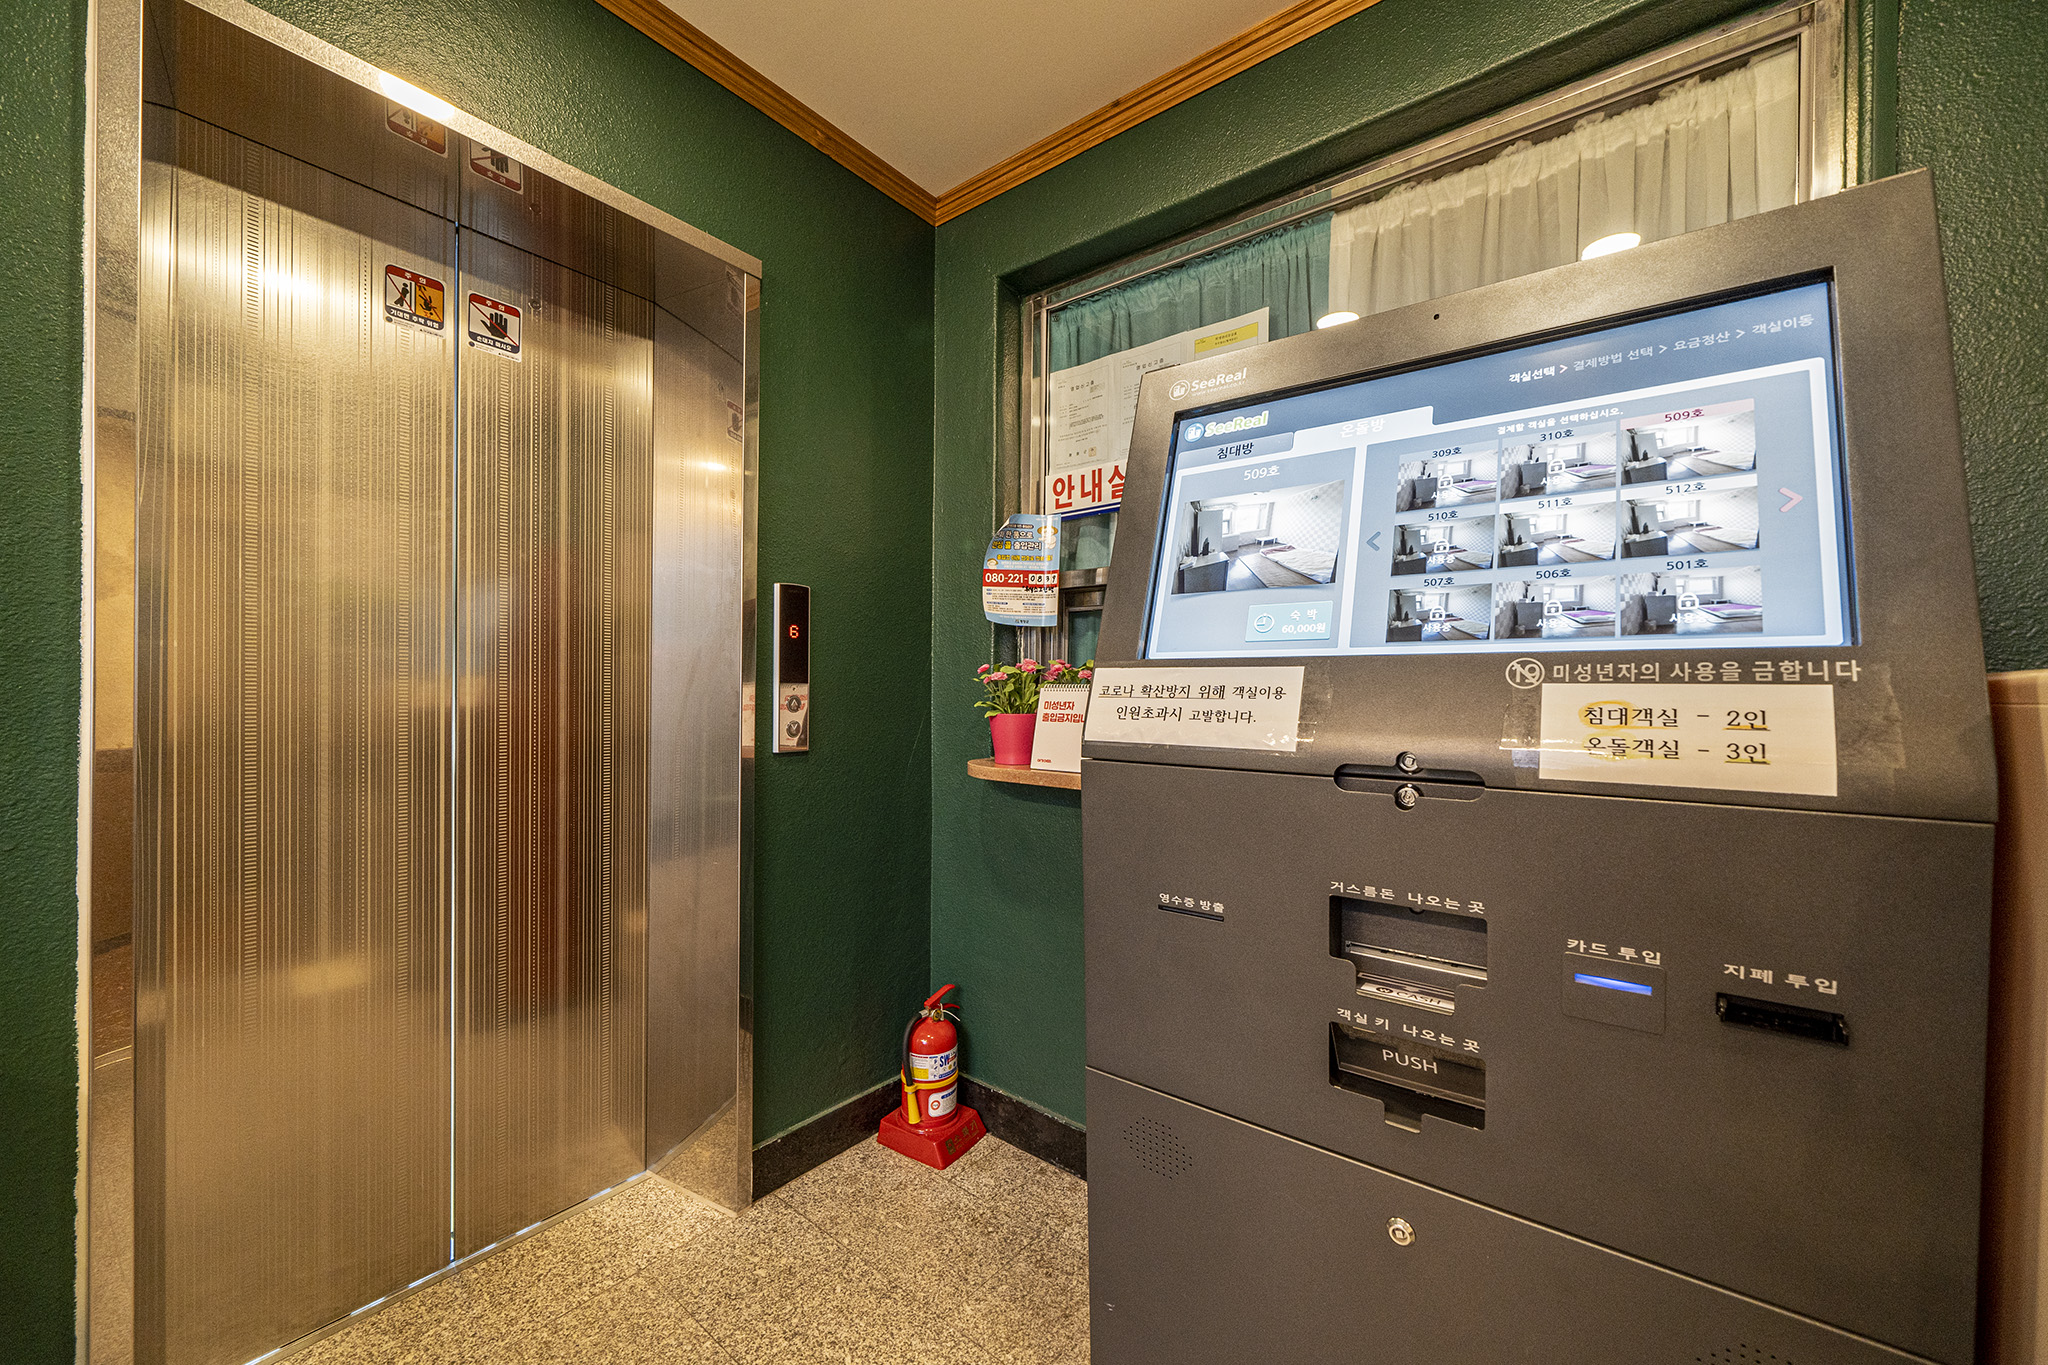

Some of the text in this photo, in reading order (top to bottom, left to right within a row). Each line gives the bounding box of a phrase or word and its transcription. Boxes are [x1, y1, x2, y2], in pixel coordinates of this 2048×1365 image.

[1508, 313, 1814, 383] 객실선택 결제방법 선택 요금정산 객실이동
[1191, 367, 1247, 391] SeeReal
[1204, 410, 1269, 437] SeeReal
[1527, 417, 1556, 429] 객실을
[1560, 407, 1624, 425] 선택하십시오.
[1664, 408, 1705, 423] 509호
[1340, 418, 1386, 438] 온돌방
[1540, 429, 1574, 441] 310호
[1217, 442, 1254, 459] 침대방
[1432, 446, 1462, 459] 309호
[1243, 465, 1280, 481] 509호
[1665, 482, 1706, 495] 512호
[1538, 497, 1573, 509] 511호
[1428, 510, 1458, 522] 510호
[1427, 554, 1456, 564] 사용중
[1665, 558, 1709, 570] 501호
[1423, 577, 1455, 587] 507호
[1535, 568, 1572, 580] 506호
[788, 624, 799, 639] 6
[1281, 622, 1326, 635] 60,000원
[1422, 622, 1452, 632] 사용중
[1553, 659, 1862, 683] 미성년자의 사용을 금합니다
[1099, 684, 1287, 700] 코로나 확산방지 위해 객실이용
[1043, 700, 1075, 711] 미성년자
[1116, 705, 1257, 724] 인원초과시 고발합니다.
[1584, 706, 1679, 728] 침대객실
[1726, 709, 1767, 730] 2인
[1583, 737, 1680, 760] 온돌객실
[1726, 742, 1767, 763] 3인
[1158, 893, 1225, 913] 영수증 방출
[1330, 880, 1485, 914] 거스름돈 나오는 곳
[1567, 938, 1662, 966] 카드 투입
[1724, 963, 1838, 996] 지폐 투입
[1396, 991, 1441, 1005] CASH
[1337, 1007, 1481, 1054] 객실 키 나오는 곳
[1382, 1048, 1438, 1075] PUSH
